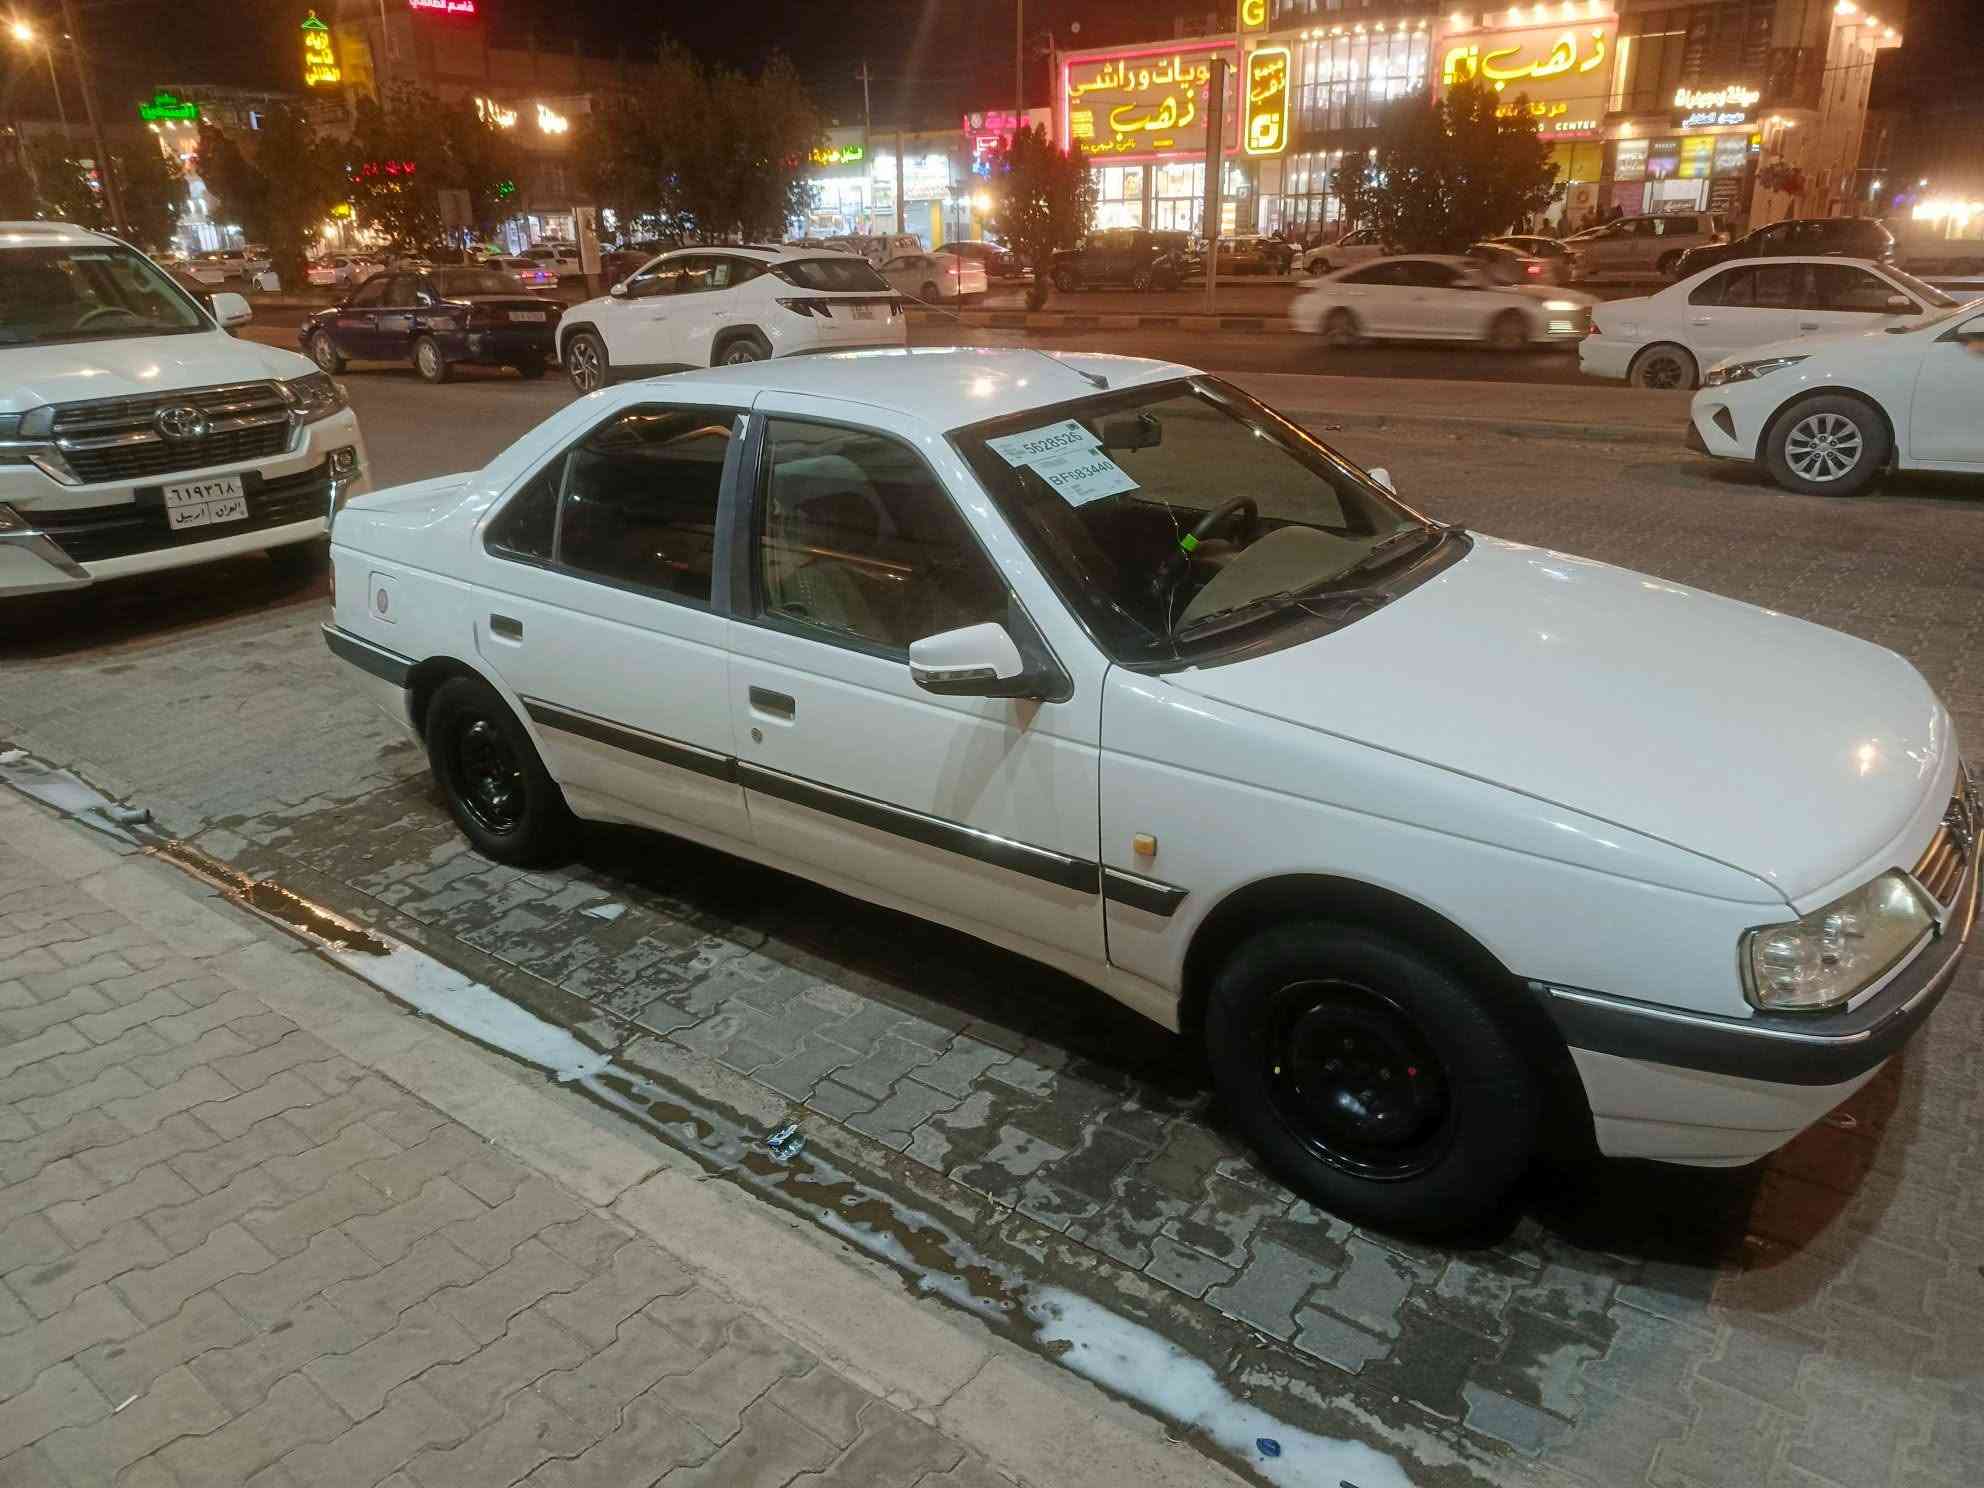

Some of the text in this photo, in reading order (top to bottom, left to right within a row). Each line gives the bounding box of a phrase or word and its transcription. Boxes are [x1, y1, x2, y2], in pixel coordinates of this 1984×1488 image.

[1481, 29, 1606, 92] ذهب
[1250, 71, 1286, 104] ذهب
[1109, 88, 1197, 142] ذهب
[1024, 431, 1083, 455] 5628526
[1049, 461, 1115, 486] BF083440
